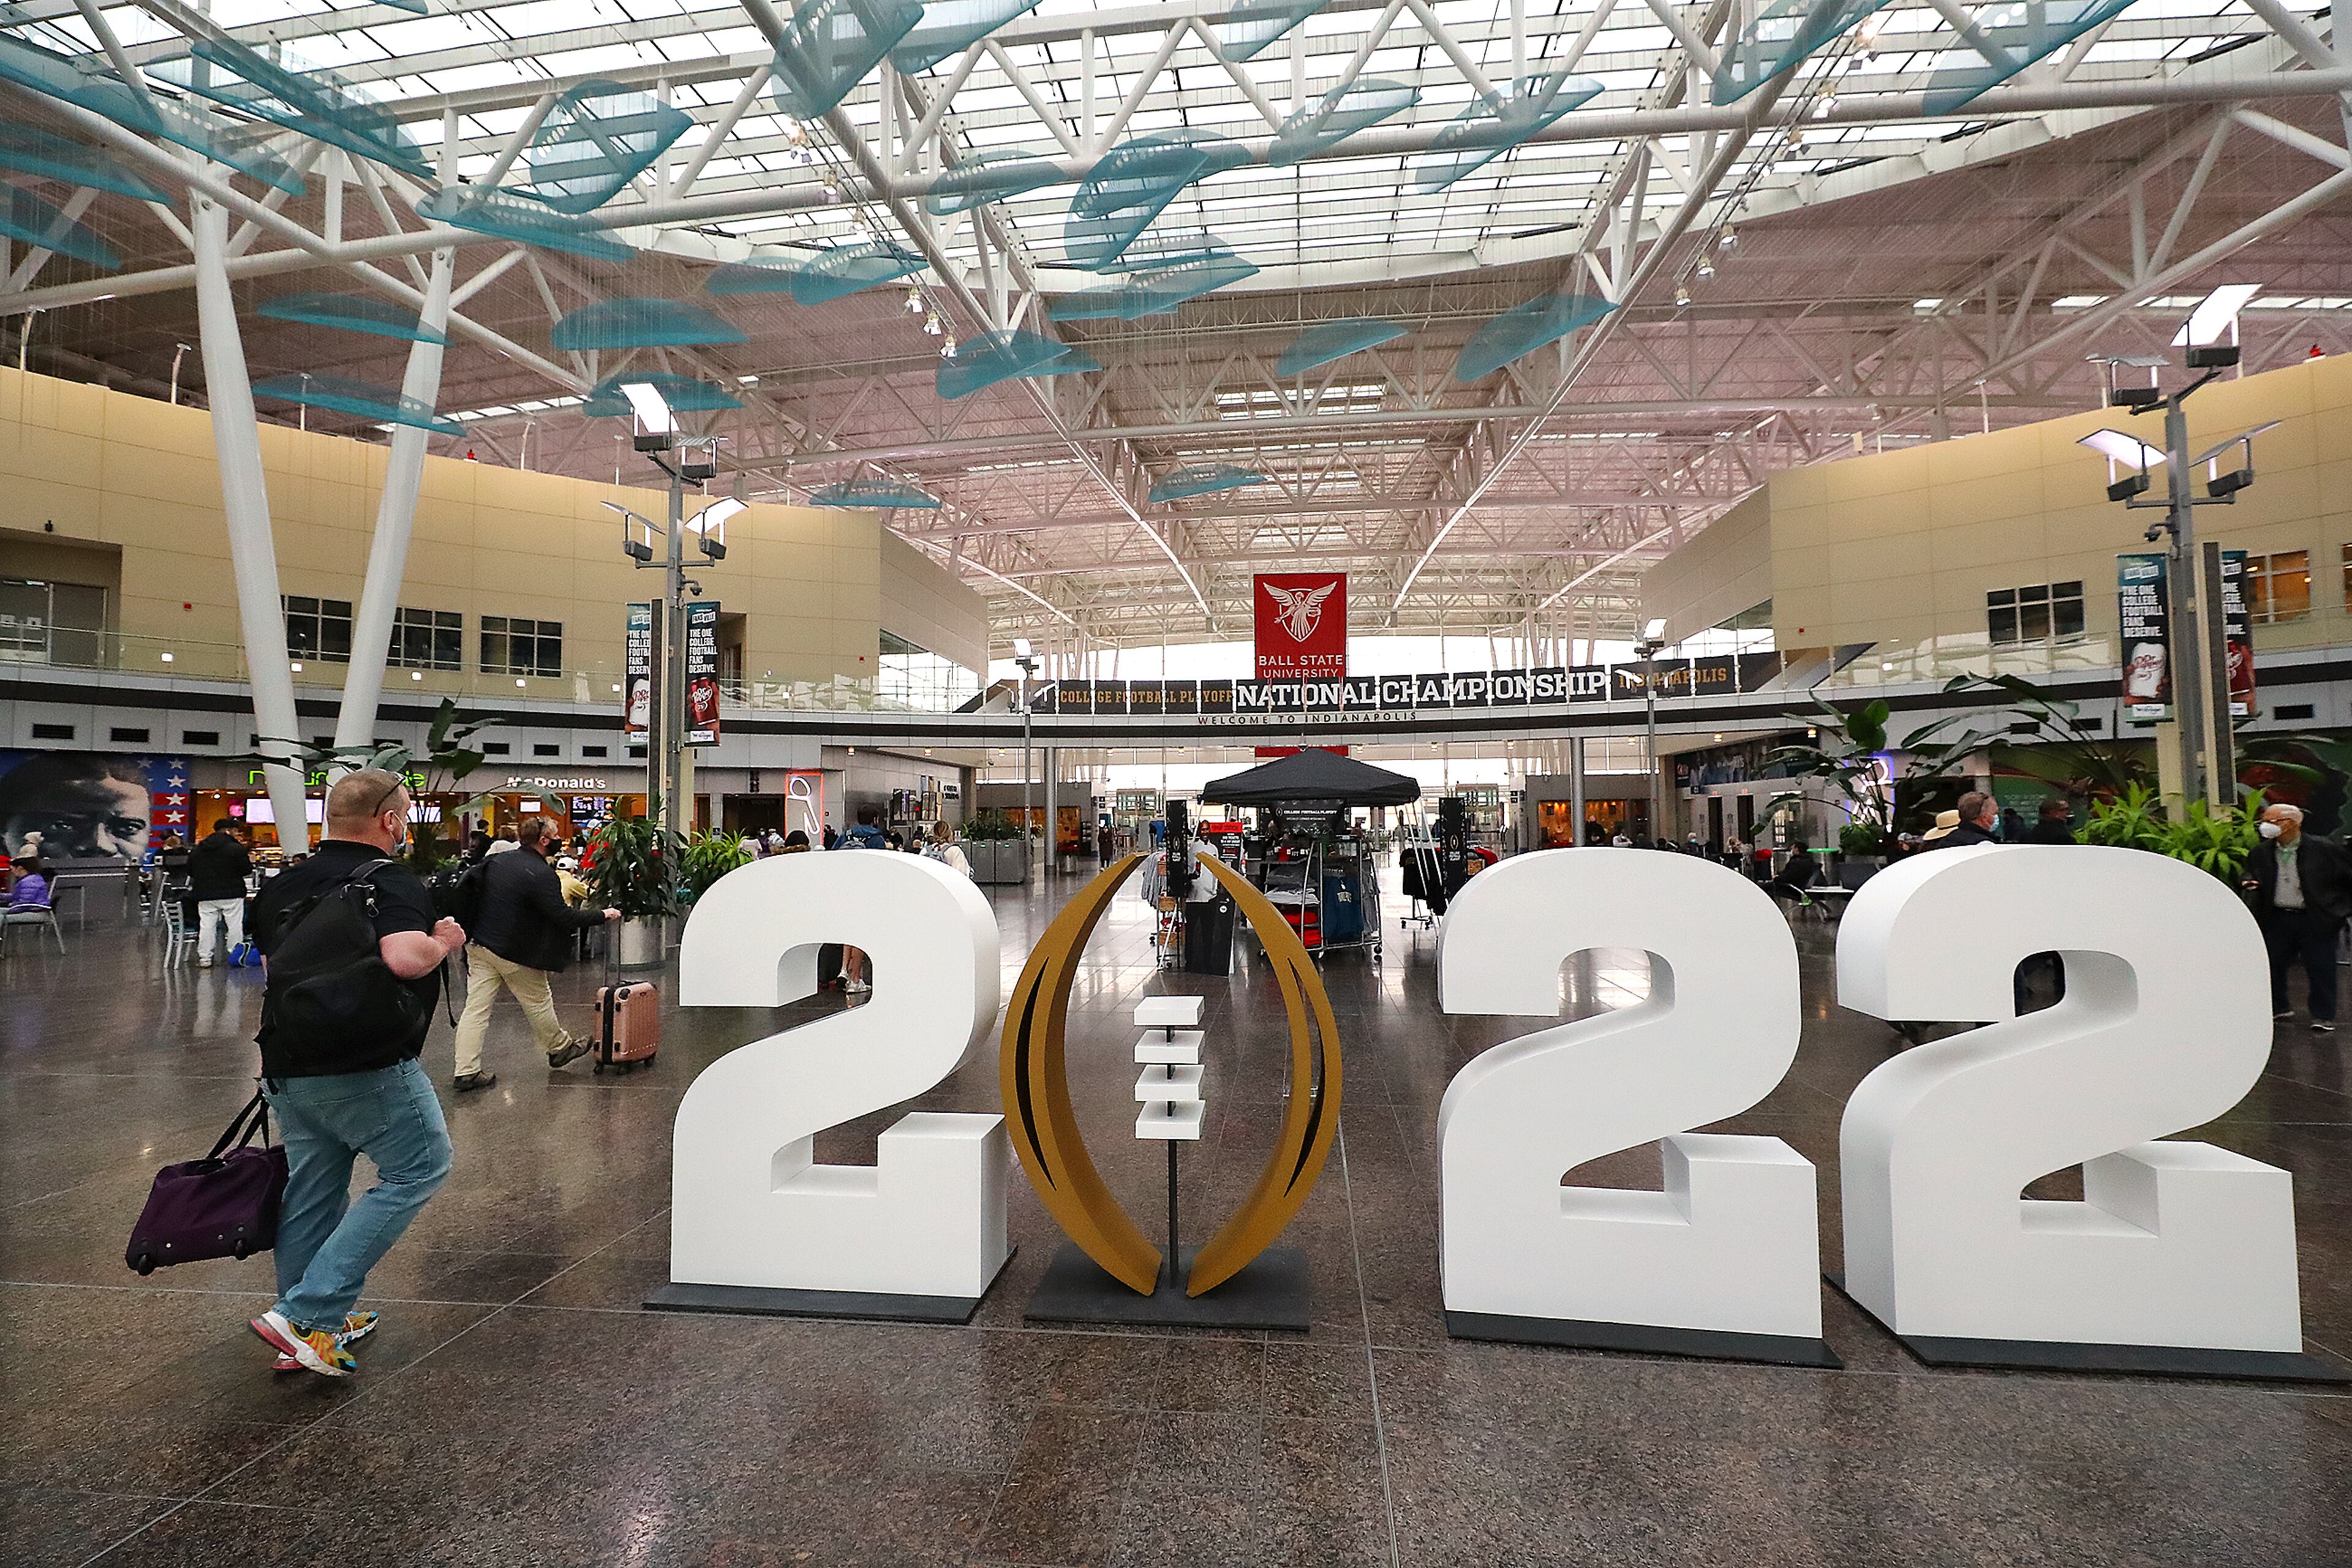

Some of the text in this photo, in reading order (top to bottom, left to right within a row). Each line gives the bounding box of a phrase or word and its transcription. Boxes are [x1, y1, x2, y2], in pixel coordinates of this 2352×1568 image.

[690, 628, 713, 638] THE ONE
[689, 637, 715, 647] COLLEGE
[688, 646, 718, 656] FOOTBALL
[628, 657, 644, 665] FANS
[688, 656, 704, 665] FANS
[1259, 655, 1343, 666] BALL STATE
[1263, 668, 1338, 678] UNIVERSITY
[1237, 671, 1606, 707] NATIONAL CHAMPIONSHIP
[1060, 690, 1112, 703] COLLGE
[1180, 690, 1232, 703] PLYOFF
[1197, 712, 1417, 725] WELCOME TO INDIANAPOLIS
